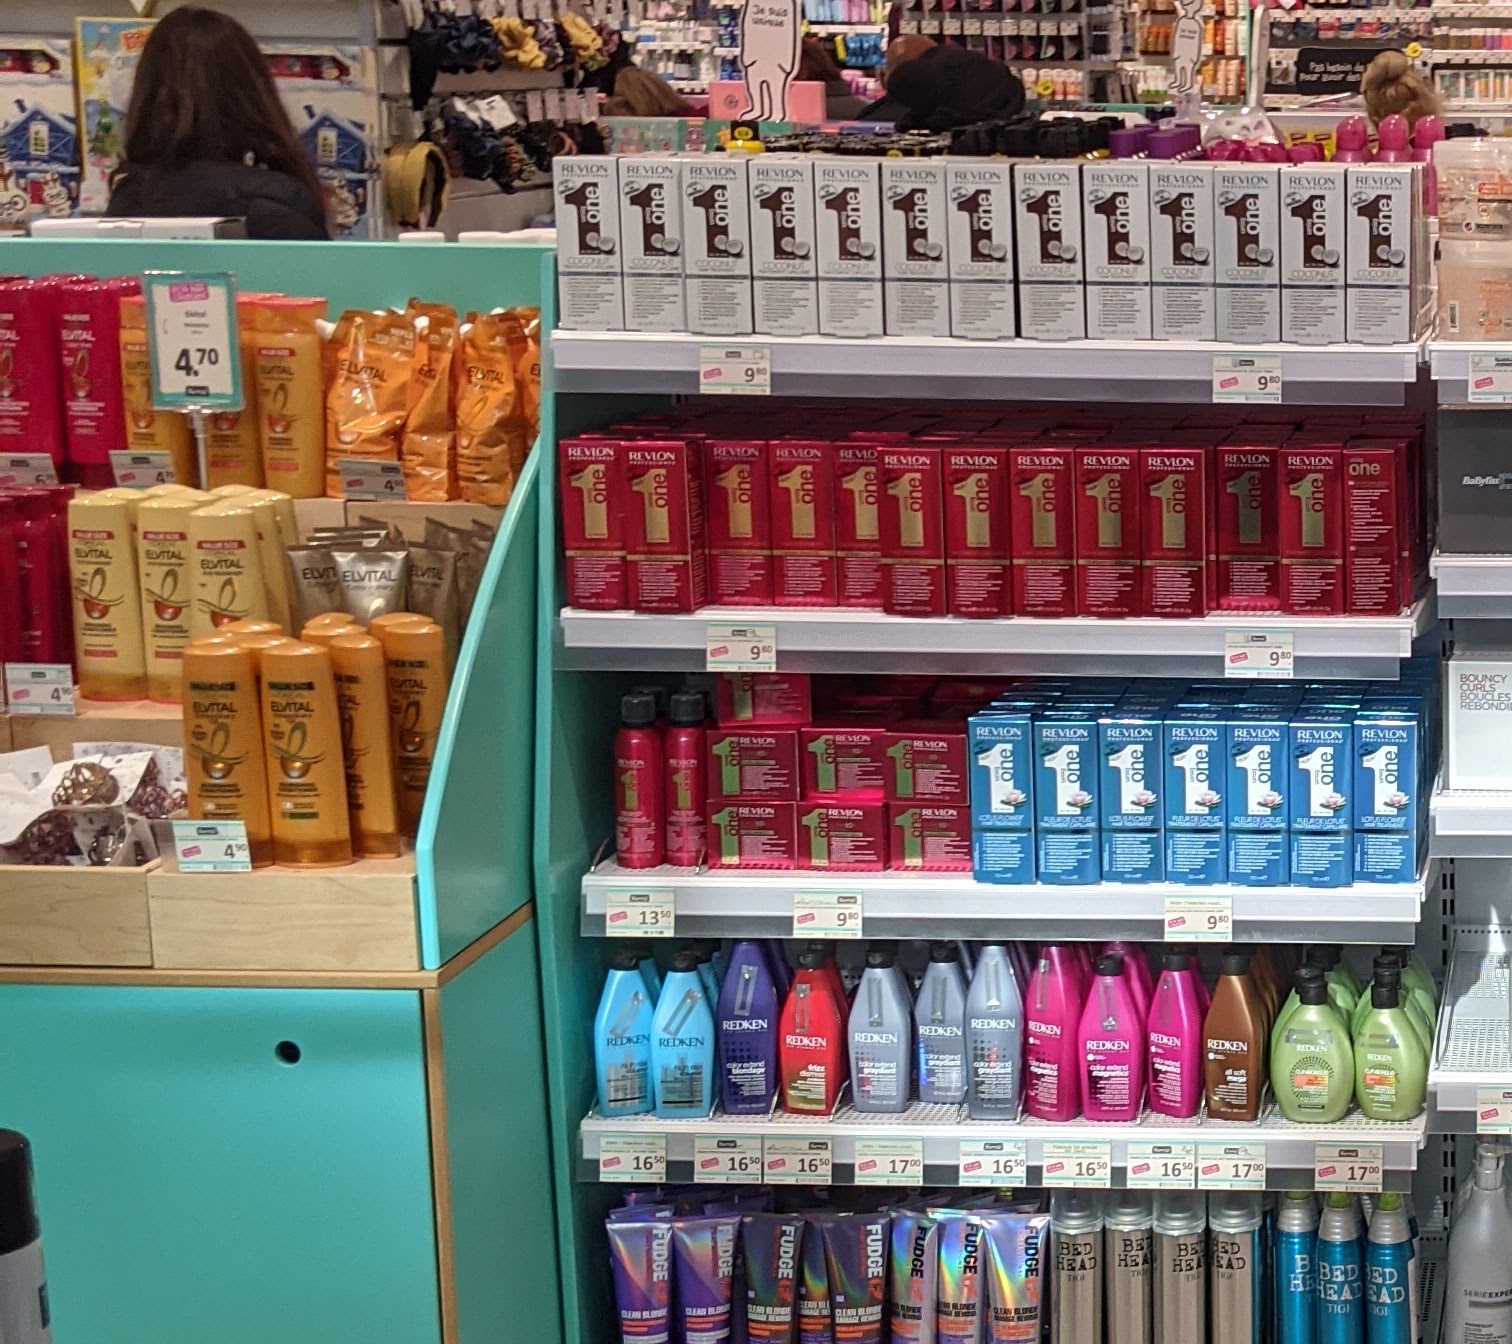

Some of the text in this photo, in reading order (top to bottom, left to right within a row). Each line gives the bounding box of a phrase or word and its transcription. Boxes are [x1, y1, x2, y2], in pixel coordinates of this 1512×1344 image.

[562, 165, 608, 174] REVLON
[690, 167, 736, 176] REVLON
[823, 169, 869, 179] REVLON
[1158, 174, 1203, 185] REVLON
[1356, 176, 1401, 186] REVLON
[587, 185, 599, 223] one
[1116, 196, 1129, 233] one
[629, 452, 675, 461] REVLON
[840, 449, 877, 458] REVLO
[884, 456, 930, 466] REVLON
[1288, 456, 1333, 466] REVLON
[977, 473, 989, 512] one
[145, 549, 184, 560] ELVITAL
[201, 559, 245, 569] ELVITAL
[1460, 674, 1508, 683] BOUNCY
[1460, 683, 1496, 692] CURLS
[1460, 692, 1511, 702] BOUCLES
[271, 702, 315, 712] ELVITAL
[1042, 728, 1087, 737] REVLON
[1172, 728, 1216, 737] REVLON
[1362, 729, 1407, 738] REVLON
[913, 740, 947, 750] REVLON
[1321, 752, 1333, 785] one
[723, 1019, 767, 1030] REDKEN
[971, 1019, 1015, 1029] REDKEN
[1028, 1020, 1061, 1036] REDKEN
[919, 1026, 961, 1036] REDKEN
[607, 1036, 650, 1045] REDKEN
[659, 1037, 704, 1048] REDKEN
[855, 1033, 897, 1043] REDKEN
[1207, 1039, 1248, 1051] REDKEN
[1297, 1044, 1327, 1053] REDKEN
[717, 1226, 733, 1278] FUDGE
[779, 1225, 794, 1279] FUDGE
[866, 1225, 882, 1278] FUDGE
[911, 1226, 927, 1278] FUDGE
[964, 1223, 978, 1276] FUDGE
[1024, 1226, 1039, 1277] FUDGE
[1059, 1242, 1093, 1255] BED
[653, 1229, 668, 1281] FUDGE
[1056, 1256, 1097, 1271] HEAD
[1319, 1262, 1358, 1281] BED
[1317, 1283, 1362, 1300] HEAD
